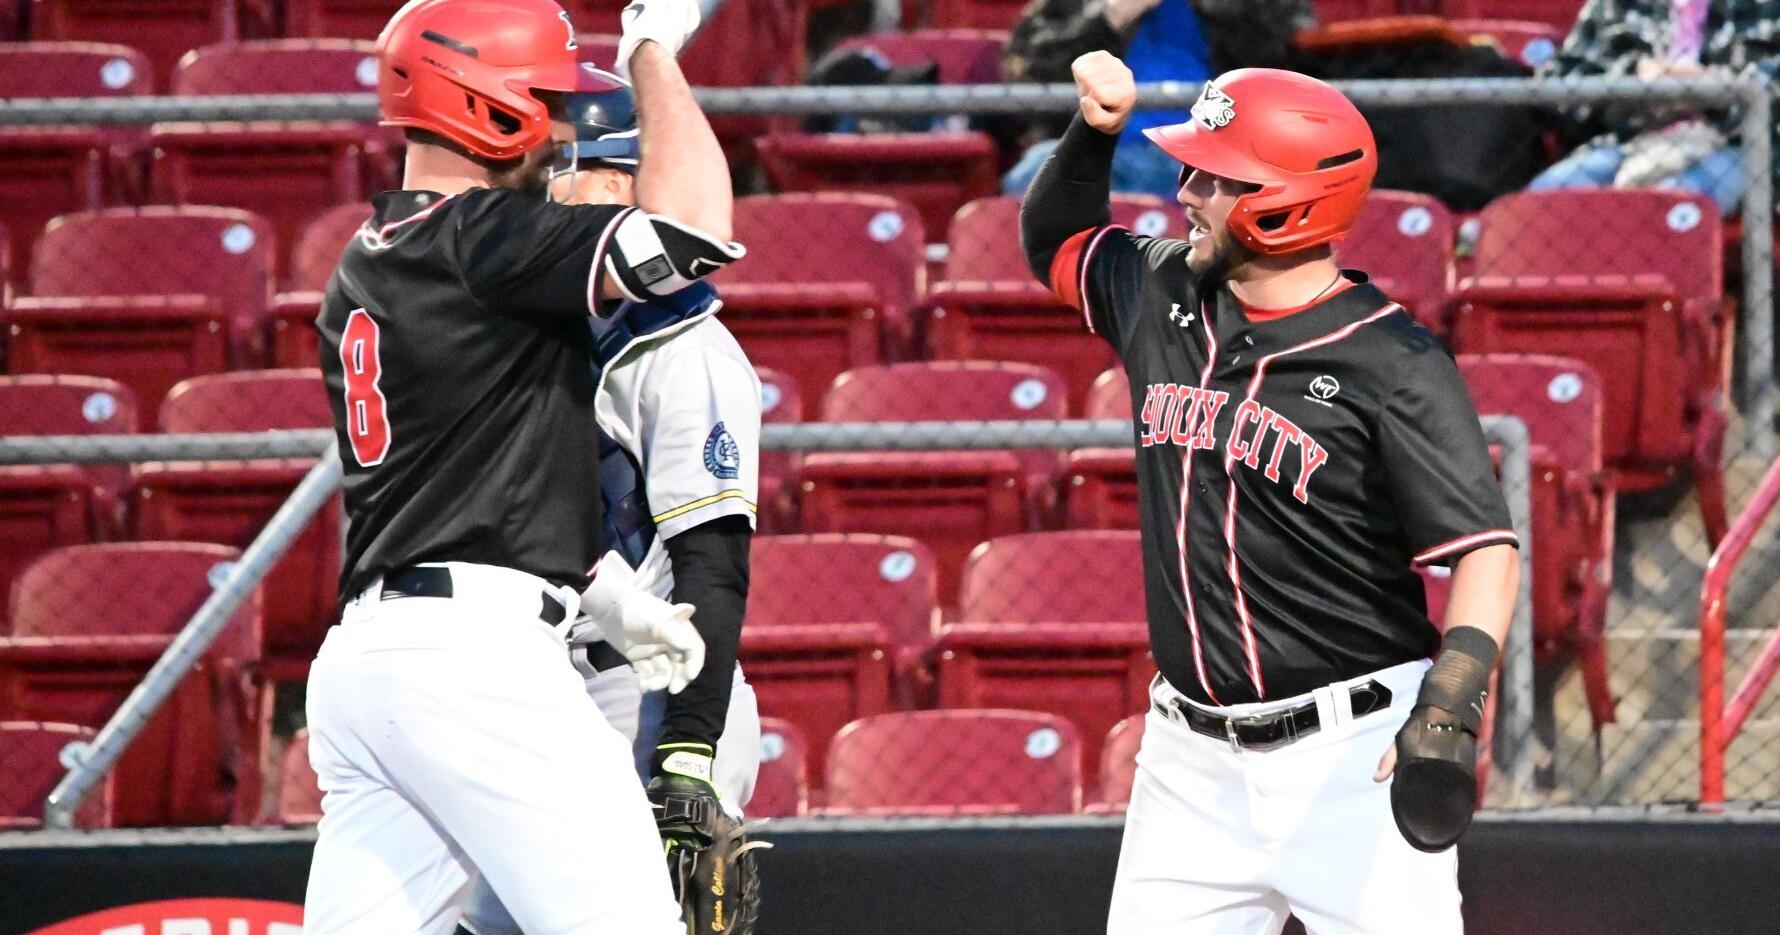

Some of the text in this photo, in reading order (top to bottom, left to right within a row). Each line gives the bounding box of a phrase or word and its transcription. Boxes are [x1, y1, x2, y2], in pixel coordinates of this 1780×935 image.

[339, 308, 392, 468] 8
[1141, 383, 1329, 504] SIOUX CITY
